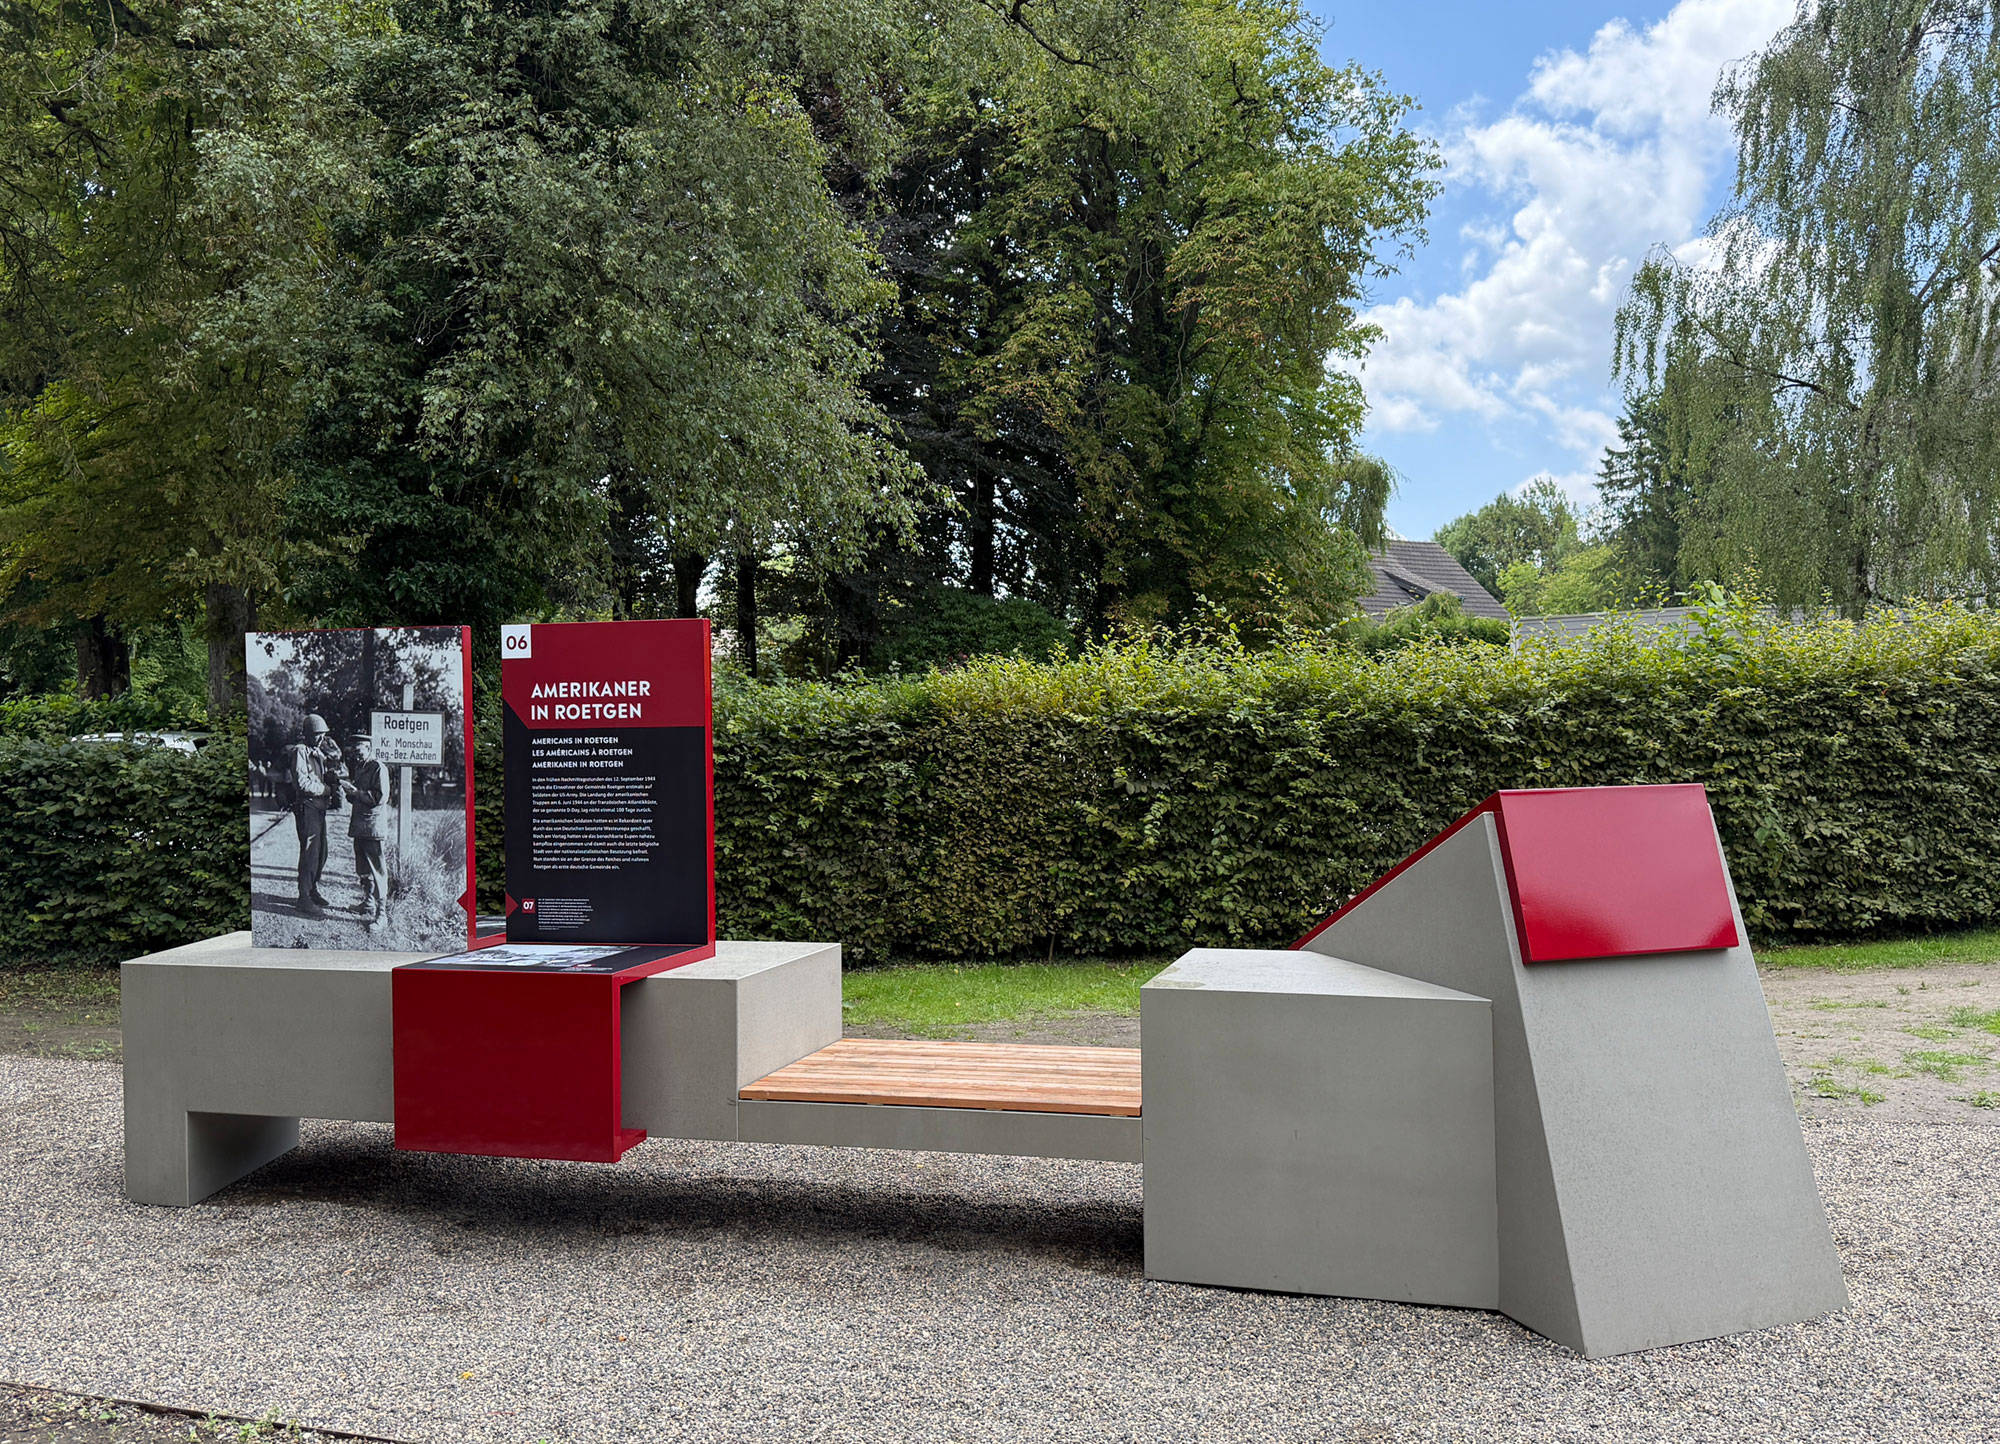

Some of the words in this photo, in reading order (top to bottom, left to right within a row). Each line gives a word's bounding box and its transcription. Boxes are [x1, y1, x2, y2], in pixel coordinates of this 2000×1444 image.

[506, 636, 527, 650] 06
[531, 681, 651, 698] AMERIKANER
[531, 705, 548, 720] IN
[555, 703, 642, 720] ROETGEN
[384, 716, 429, 733] Roetgen
[381, 737, 390, 747] Kr.
[396, 738, 432, 748] Monschau
[410, 750, 436, 760] Aachen
[546, 748, 589, 756] AMÉRICAINS
[591, 747, 597, 756] À
[523, 901, 534, 910] 07
